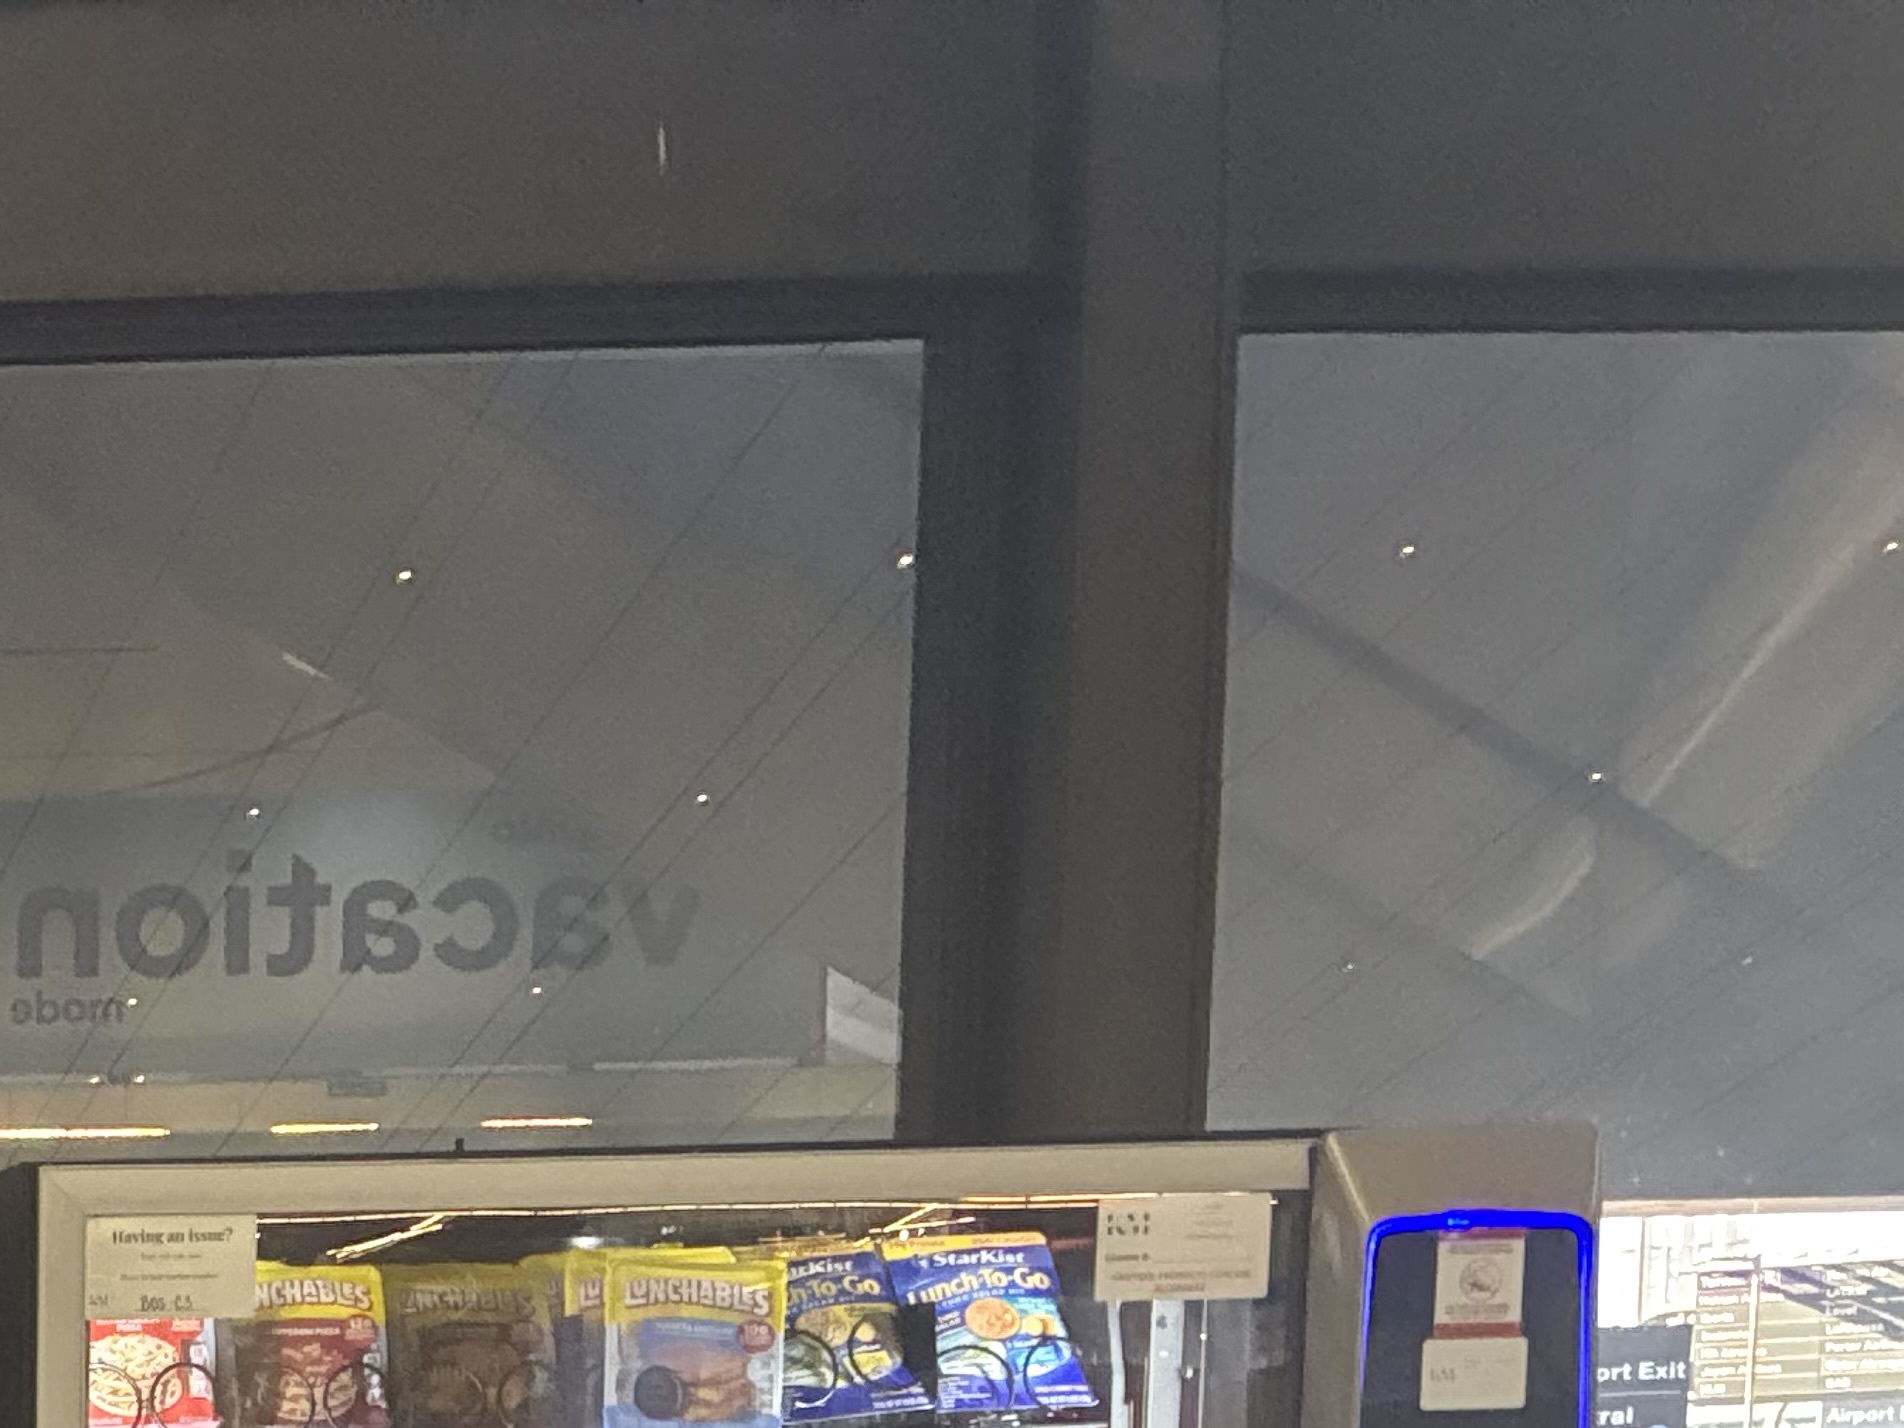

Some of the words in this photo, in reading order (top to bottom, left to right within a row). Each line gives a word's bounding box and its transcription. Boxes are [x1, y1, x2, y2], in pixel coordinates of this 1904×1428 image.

[112, 1228, 164, 1246] Having
[166, 1229, 185, 1243] an
[932, 1248, 1026, 1267] StarKist
[906, 1265, 1052, 1306] Lunch-To-Go
[624, 1277, 770, 1316] LUNCHABLES
[1638, 1361, 1686, 1381] Exit
[1826, 1406, 1894, 1426] Airport
